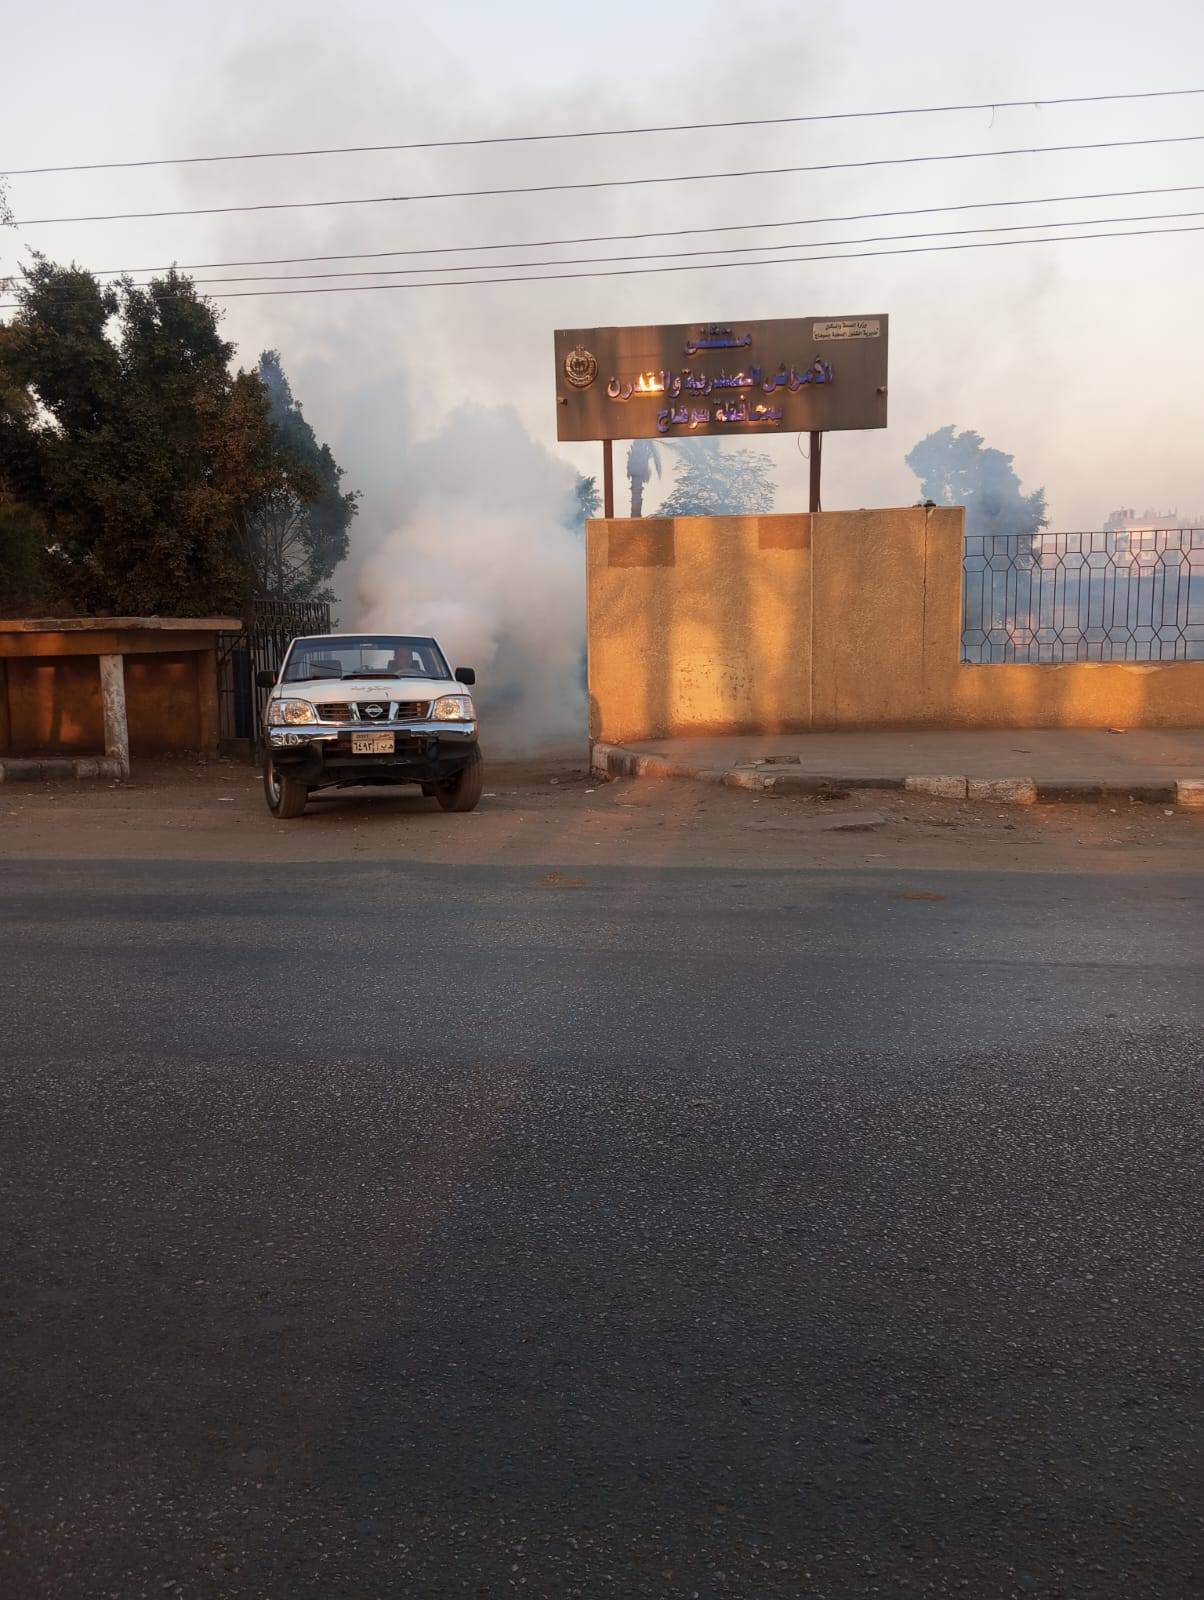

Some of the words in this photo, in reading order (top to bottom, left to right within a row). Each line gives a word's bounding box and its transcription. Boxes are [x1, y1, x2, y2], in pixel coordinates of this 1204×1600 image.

[683, 364, 760, 396] الصدرية
[762, 353, 832, 392] الأمراض
[713, 394, 783, 426] بمحافظة
